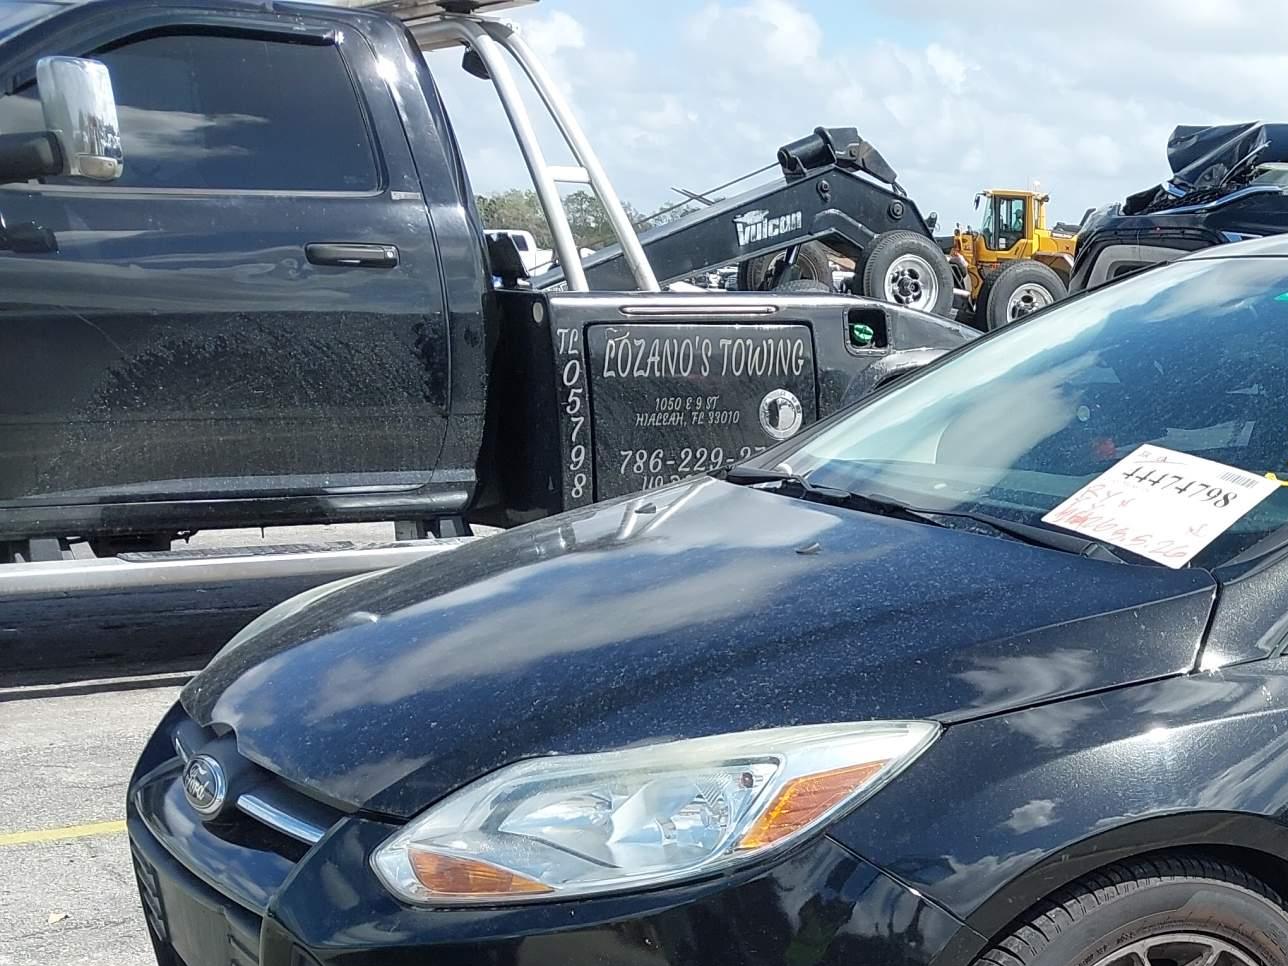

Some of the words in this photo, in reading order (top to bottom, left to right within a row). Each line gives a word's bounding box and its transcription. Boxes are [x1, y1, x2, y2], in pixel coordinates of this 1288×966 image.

[603, 331, 713, 378] LOZANO'S
[719, 337, 806, 377] TOWING
[655, 397, 682, 411] 1050
[695, 396, 702, 410] 9
[706, 395, 720, 410] ST
[635, 412, 688, 427] HIALEAH,
[692, 411, 704, 426] FL
[707, 410, 740, 425] 33010
[185, 764, 211, 801] Ford
